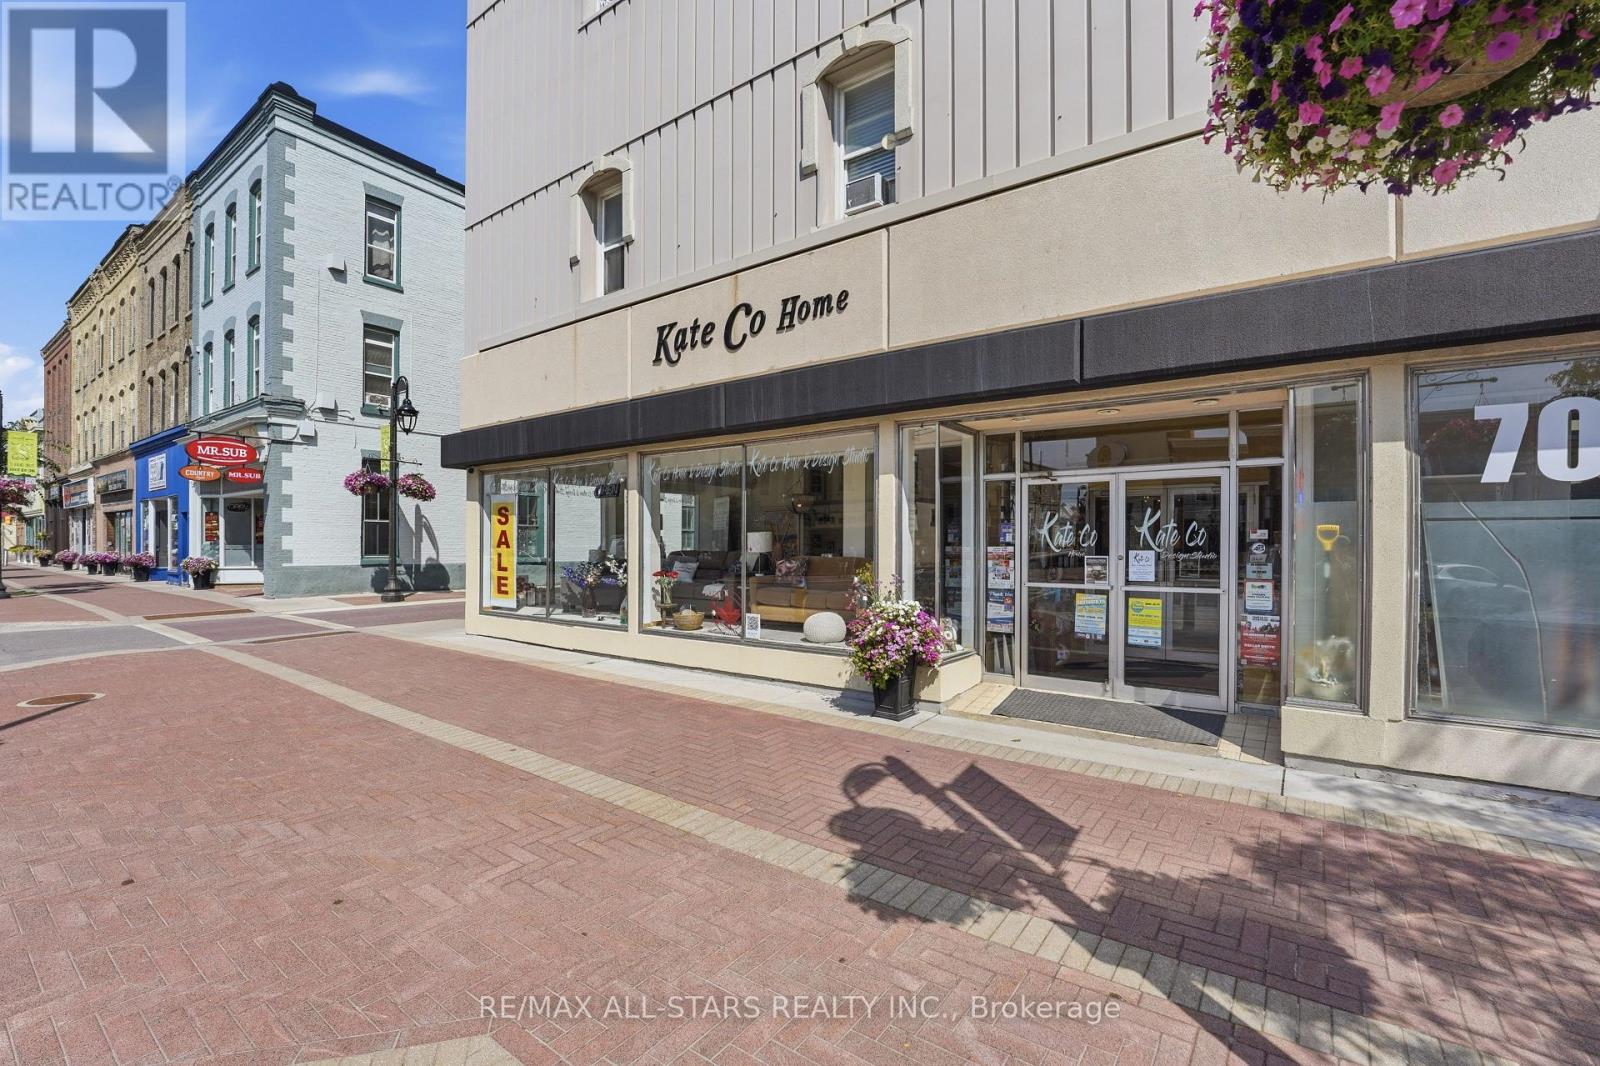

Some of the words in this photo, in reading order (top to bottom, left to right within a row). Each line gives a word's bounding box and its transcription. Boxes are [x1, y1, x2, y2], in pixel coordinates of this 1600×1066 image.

[653, 317, 716, 365] Kate
[724, 303, 766, 352] Co
[777, 290, 850, 334] Home
[811, 450, 839, 474] Design
[1474, 396, 1600, 483] 70
[496, 506, 511, 595] SALE
[1037, 511, 1075, 552] Kate
[1080, 524, 1098, 547] Co
[1135, 507, 1180, 552] Kate
[1186, 521, 1207, 547] Co
